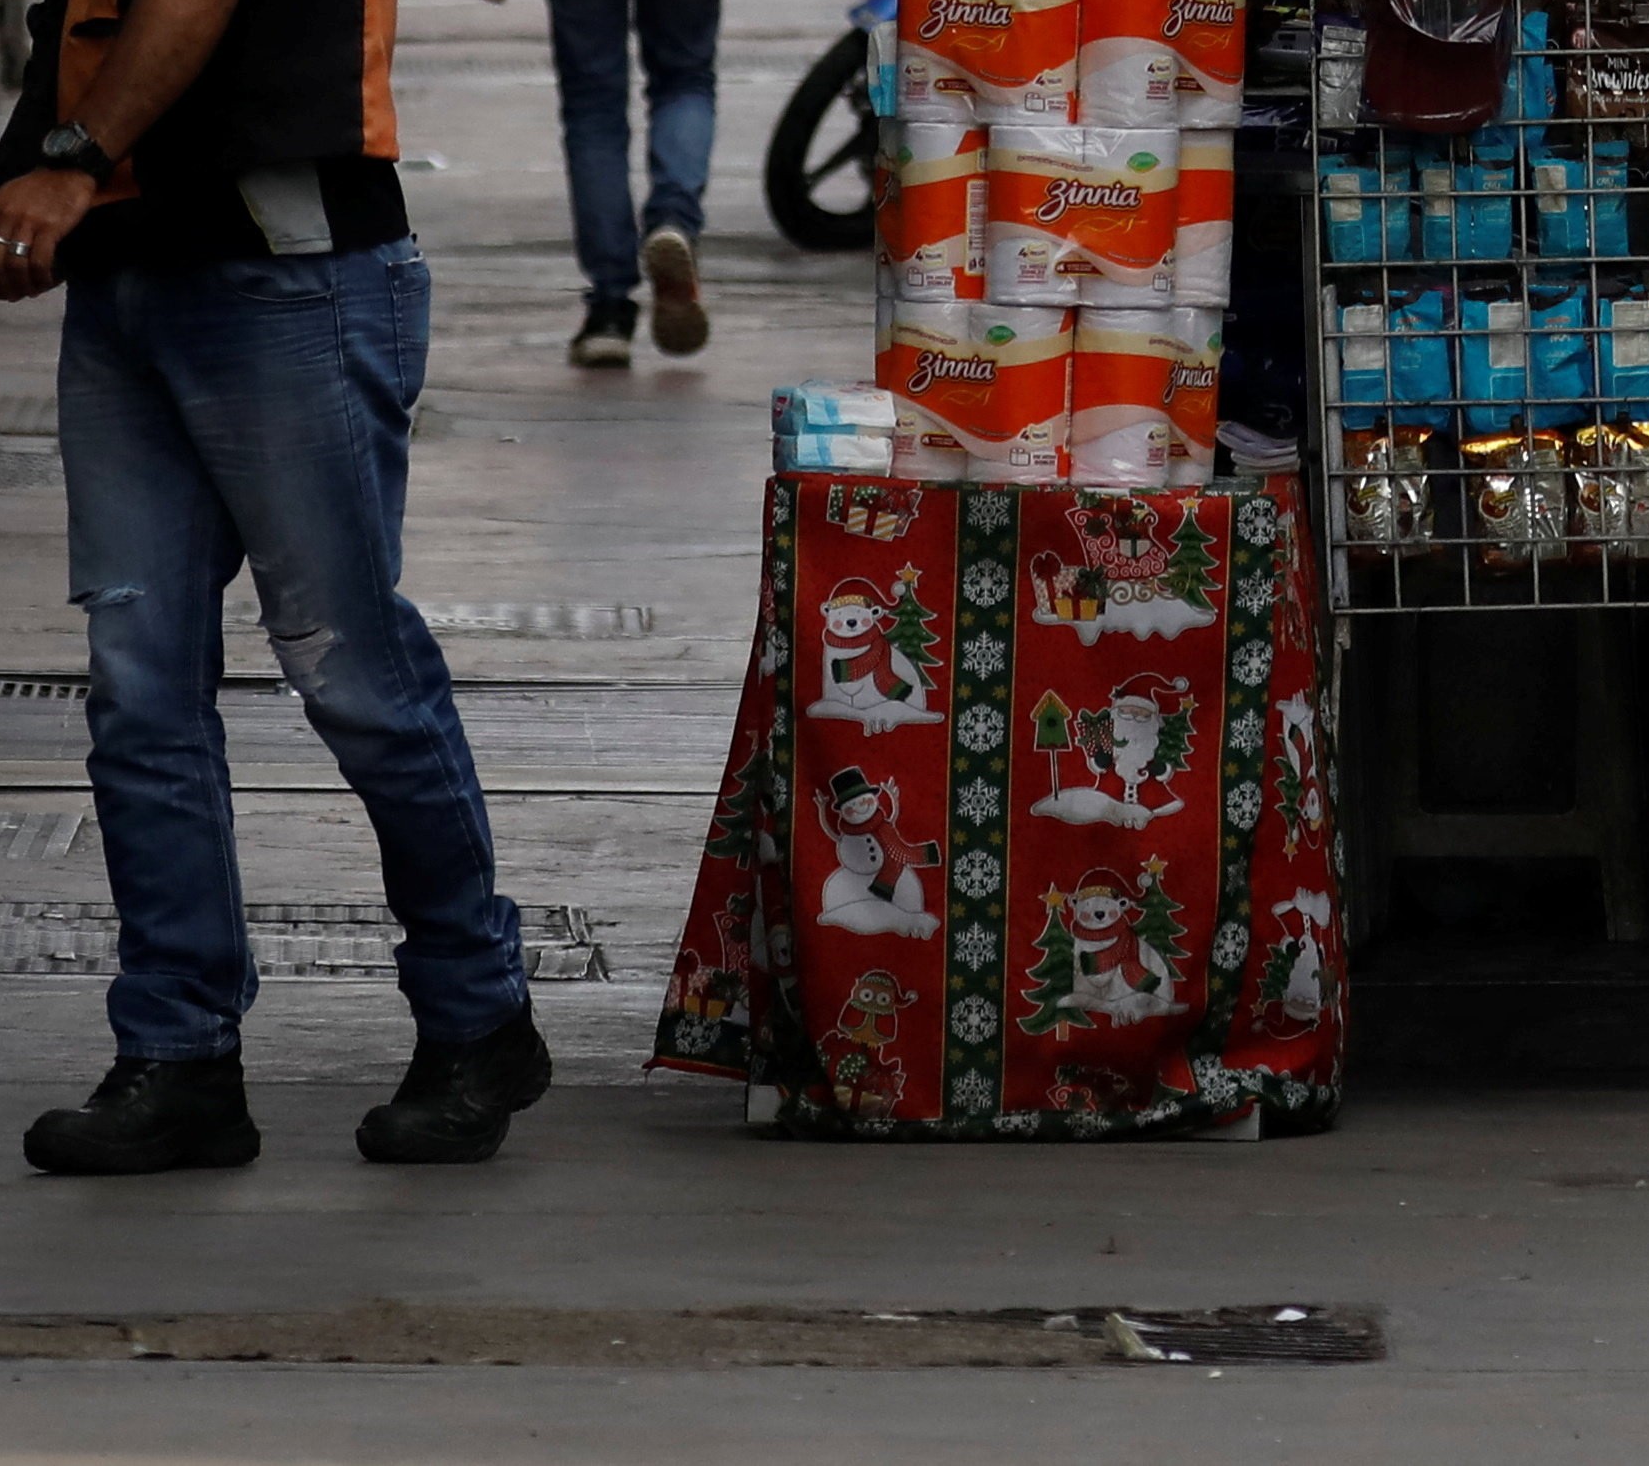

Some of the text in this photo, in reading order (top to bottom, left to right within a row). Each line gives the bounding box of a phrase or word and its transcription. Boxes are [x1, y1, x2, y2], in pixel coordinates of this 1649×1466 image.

[1037, 179, 1140, 221] Zinnia
[908, 352, 995, 392] Zinnia
[1162, 360, 1214, 403] Zinnia
